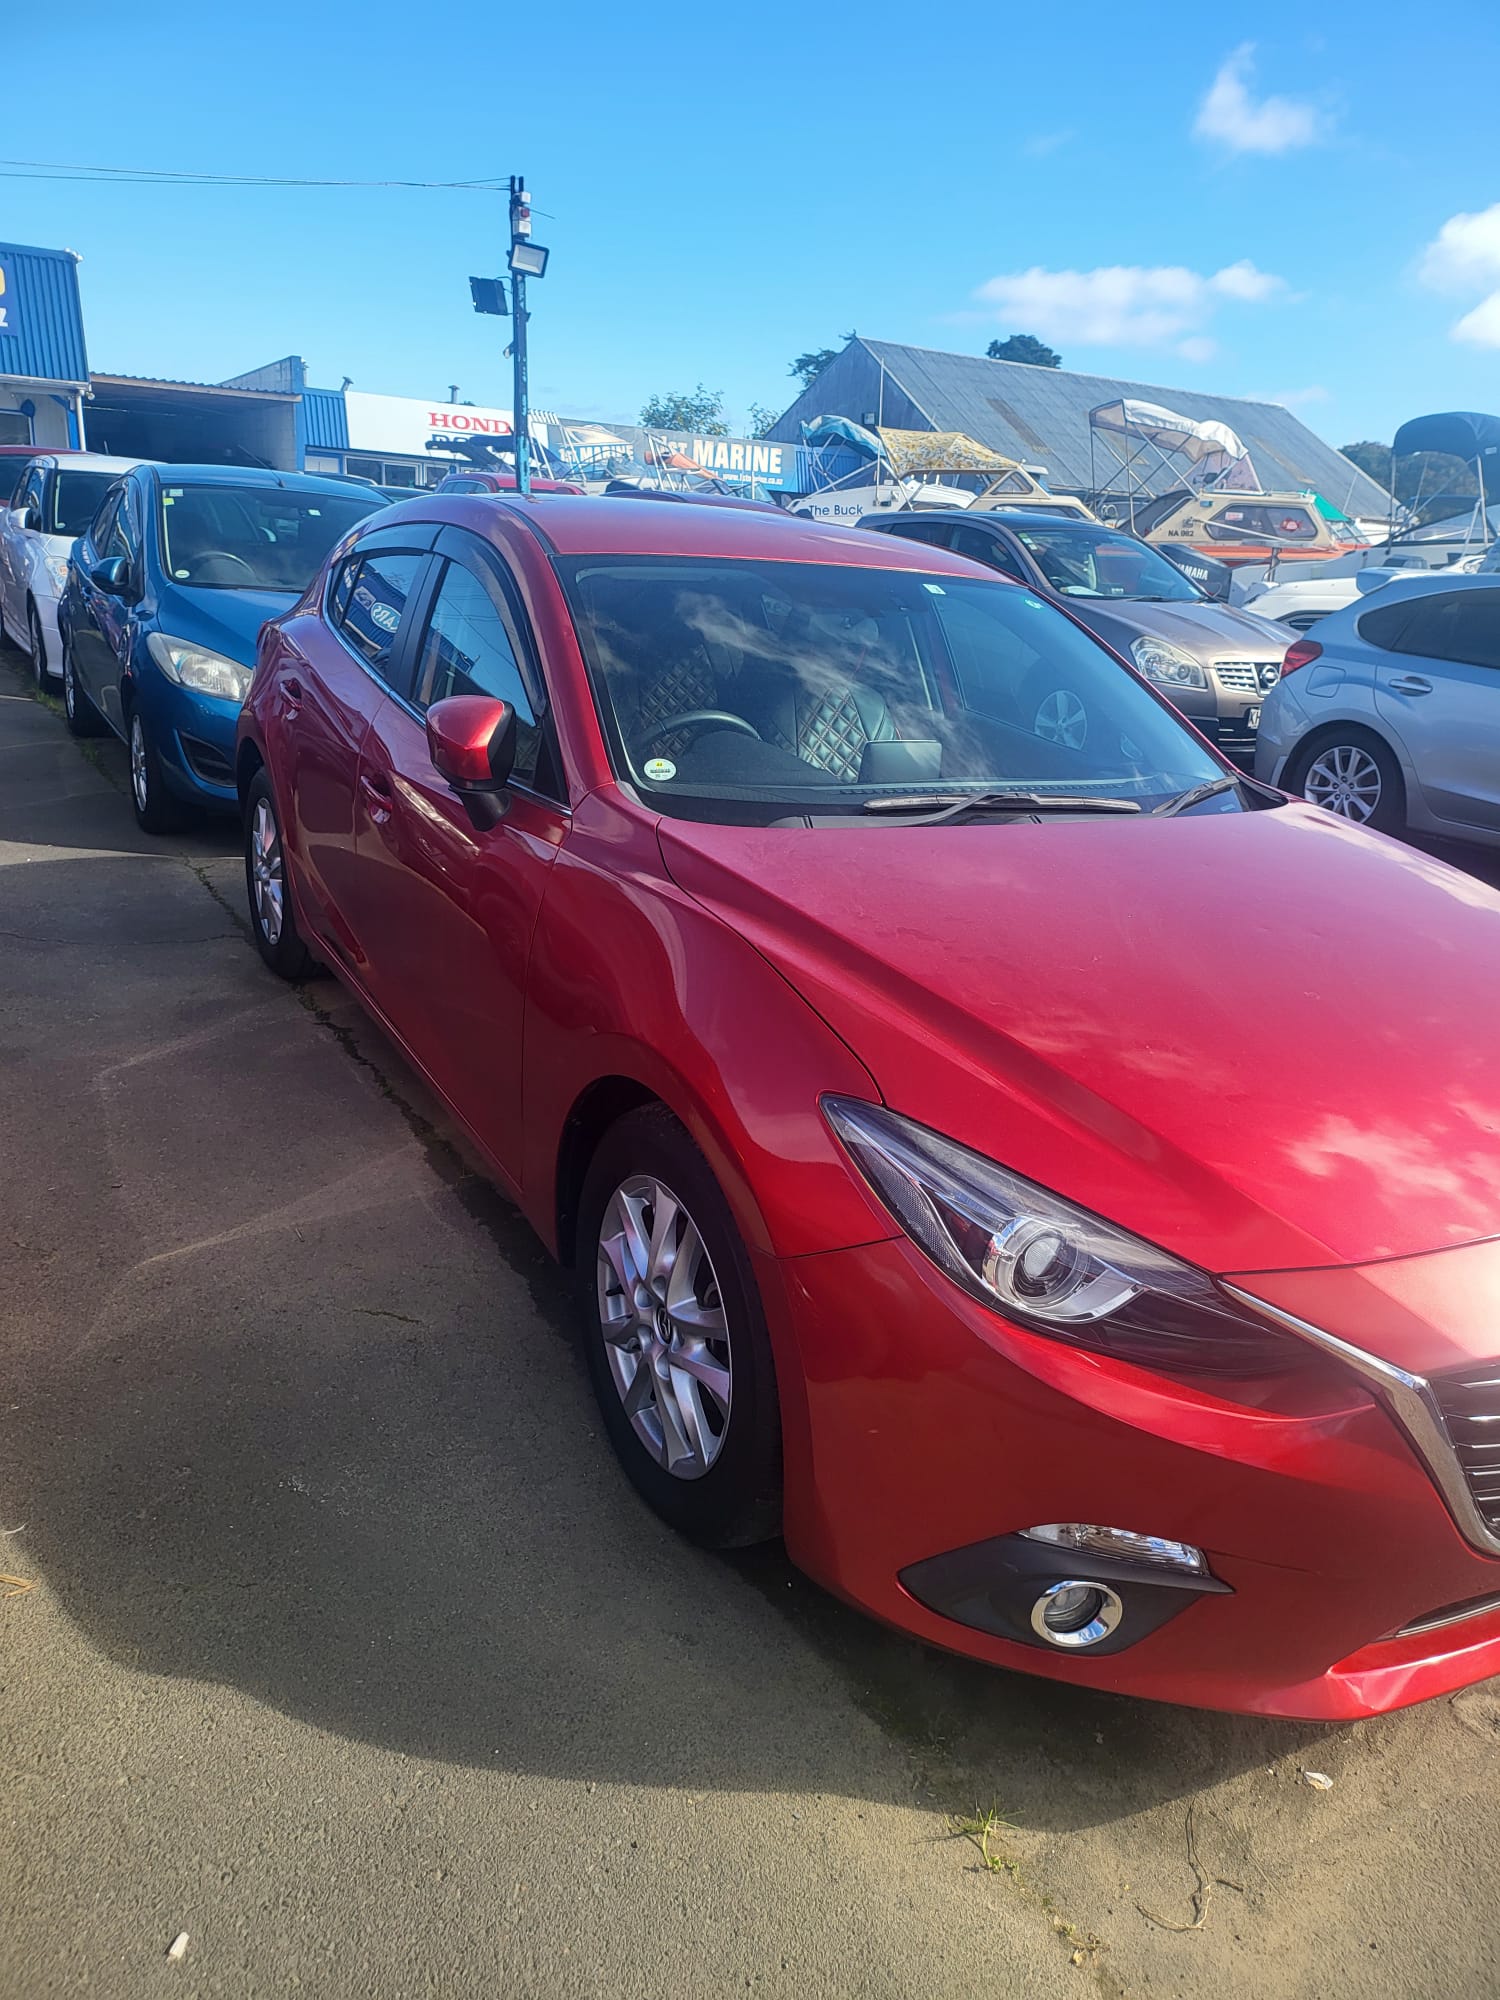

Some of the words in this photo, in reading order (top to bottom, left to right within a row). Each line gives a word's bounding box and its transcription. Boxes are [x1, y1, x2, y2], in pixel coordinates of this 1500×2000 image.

[427, 412, 511, 434] HOND
[692, 439, 783, 474] MARINE
[809, 504, 830, 516] The
[834, 504, 863, 516] Buck
[1177, 563, 1209, 581] AMAHA
